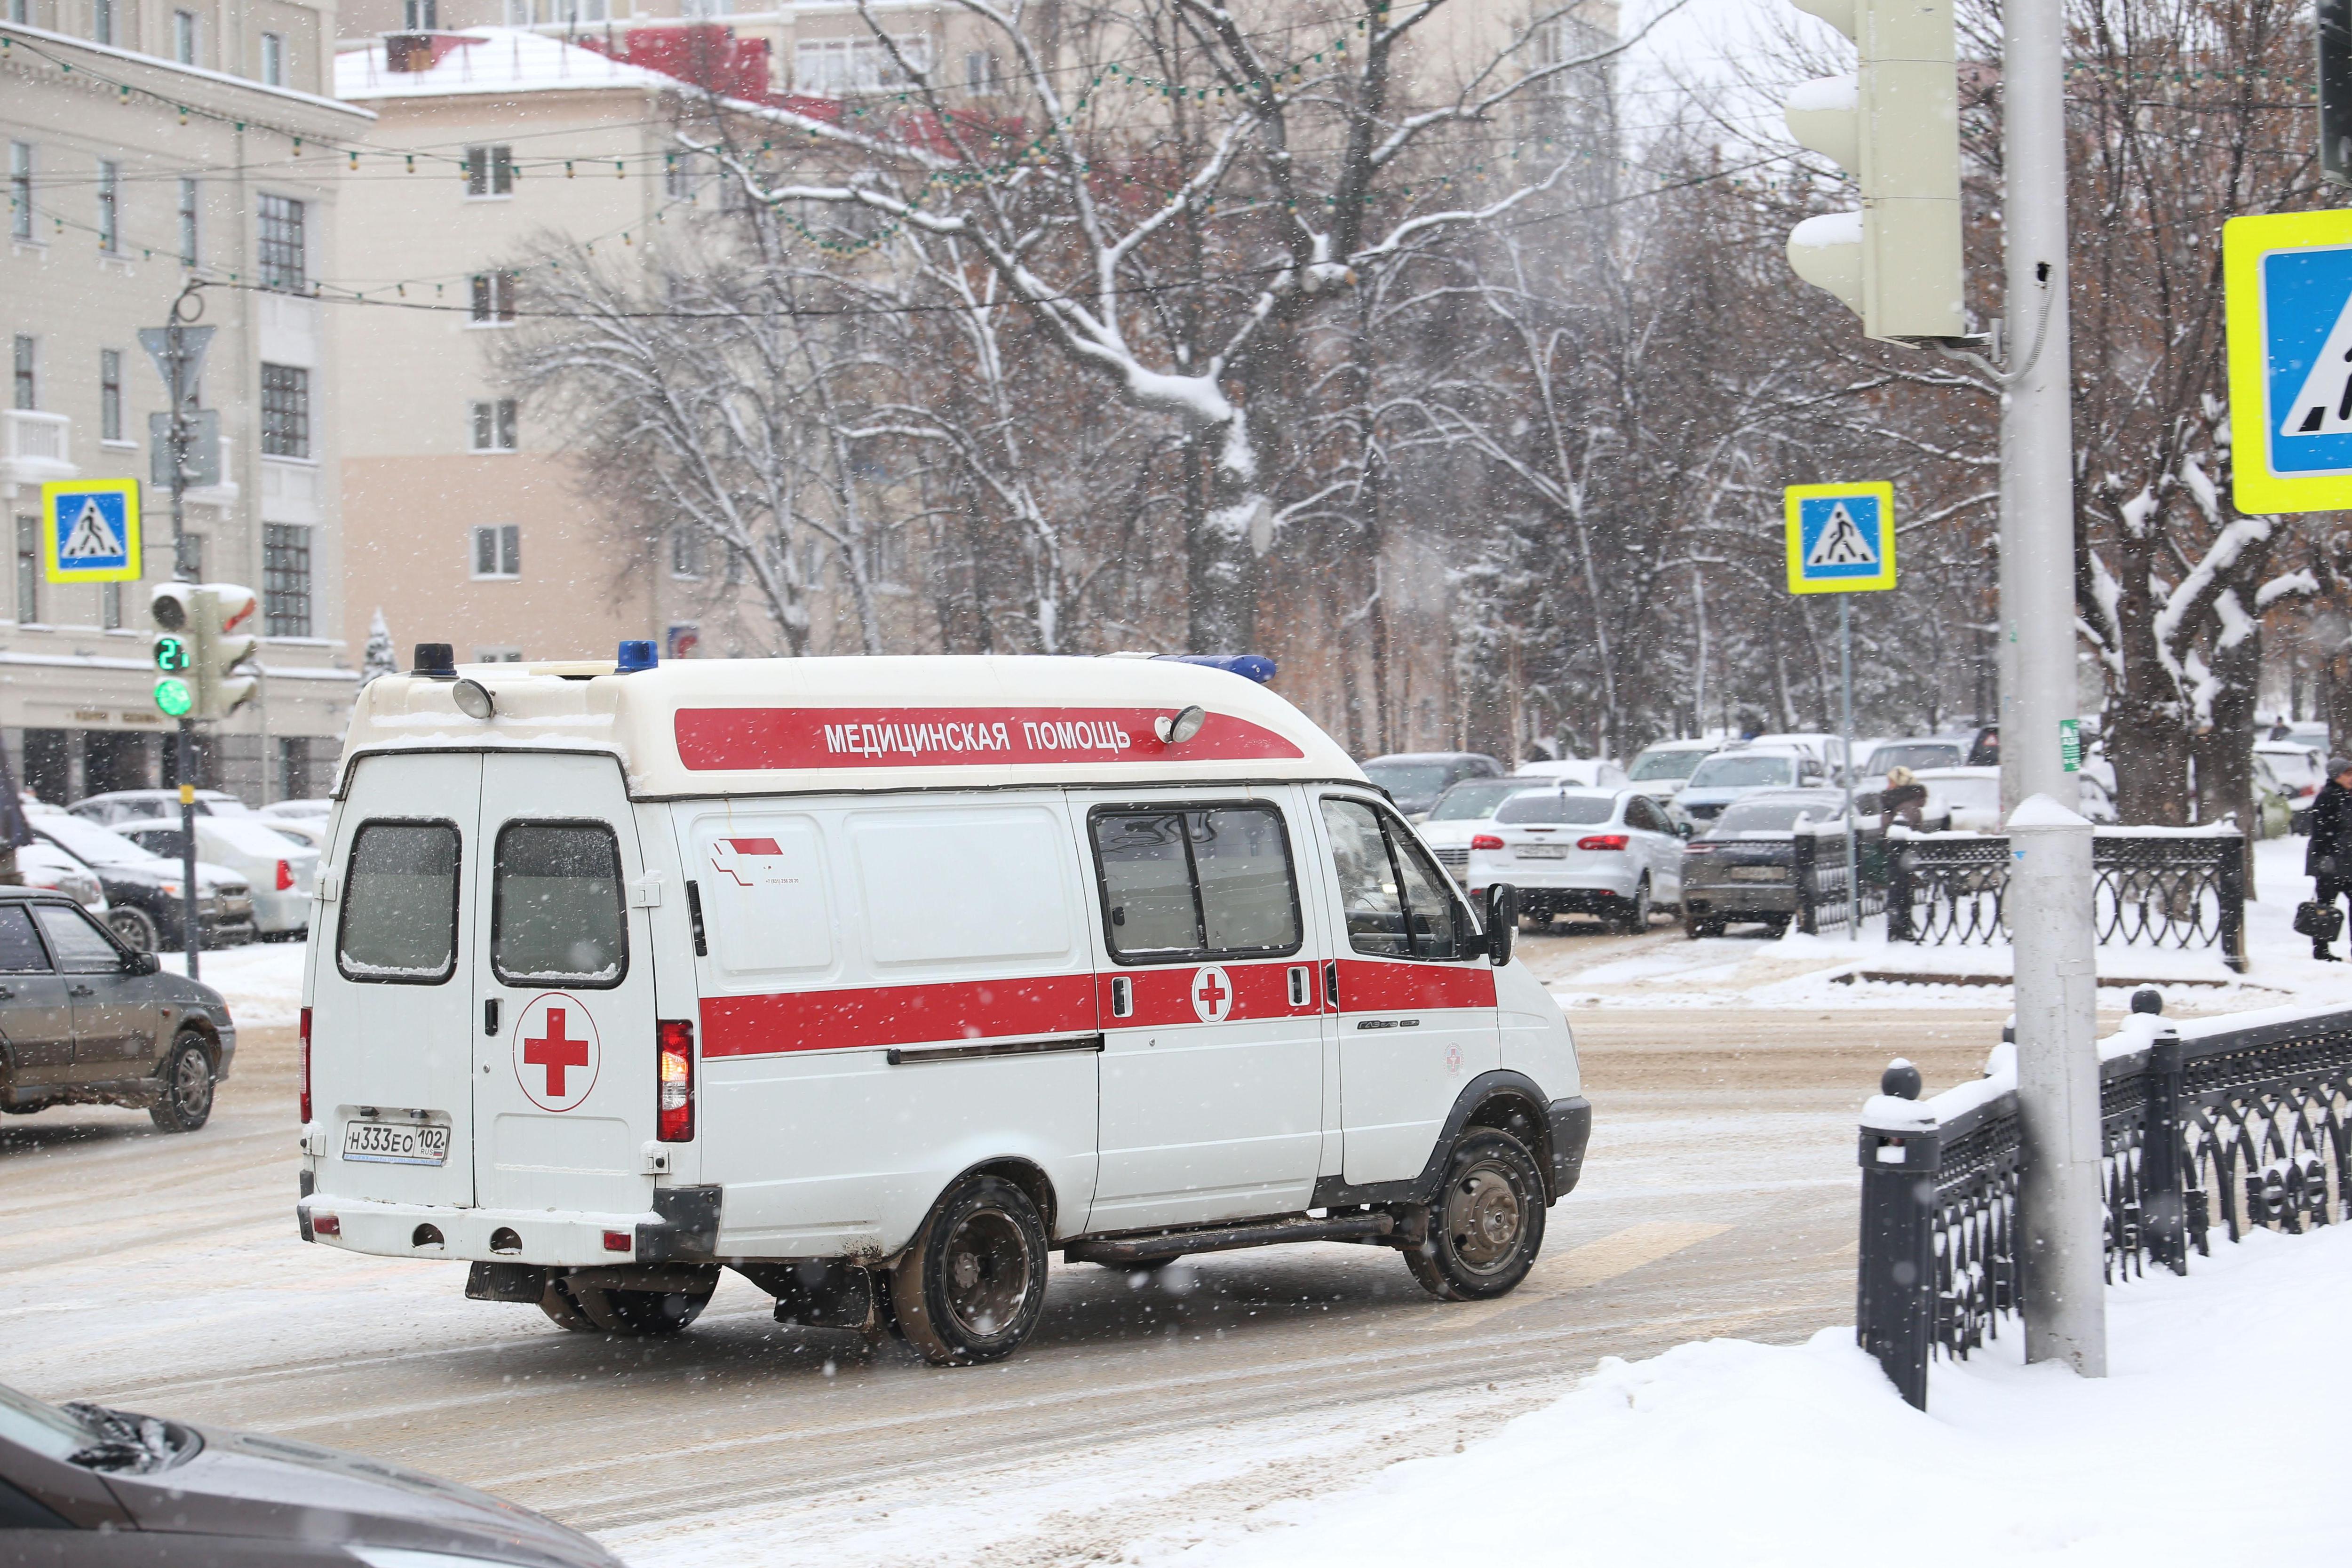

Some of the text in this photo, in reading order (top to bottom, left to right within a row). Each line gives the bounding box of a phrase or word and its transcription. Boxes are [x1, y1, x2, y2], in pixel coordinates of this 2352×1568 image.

[824, 722, 1131, 758] МЕДИЦИНСКАЯ ПОМОЩЬ
[350, 1127, 442, 1153] Н333ЕО 102
